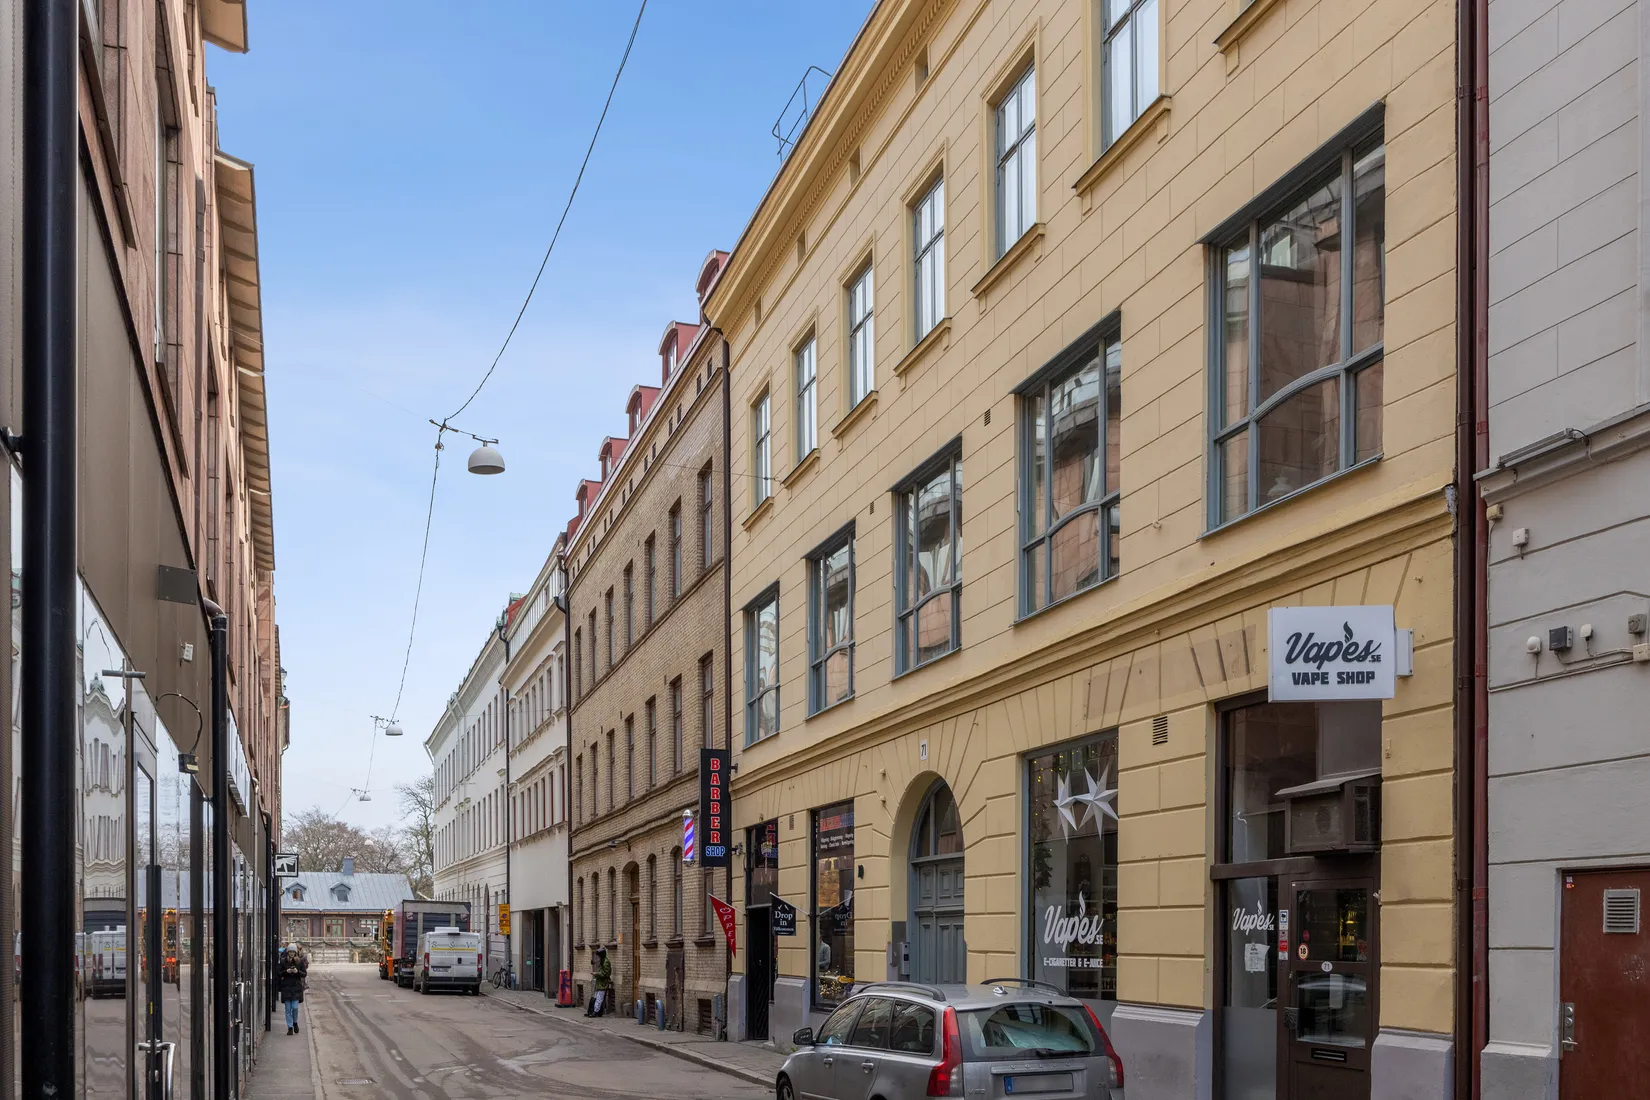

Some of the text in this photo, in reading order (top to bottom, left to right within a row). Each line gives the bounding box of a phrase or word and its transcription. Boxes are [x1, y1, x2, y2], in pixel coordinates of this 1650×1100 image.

[1291, 670, 1375, 686] VAPE SHOP
[710, 758, 720, 843] BARBER
[705, 846, 725, 857] SHOP
[774, 910, 793, 920] Drop
[780, 918, 787, 926] in
[1300, 947, 1307, 955] 18
